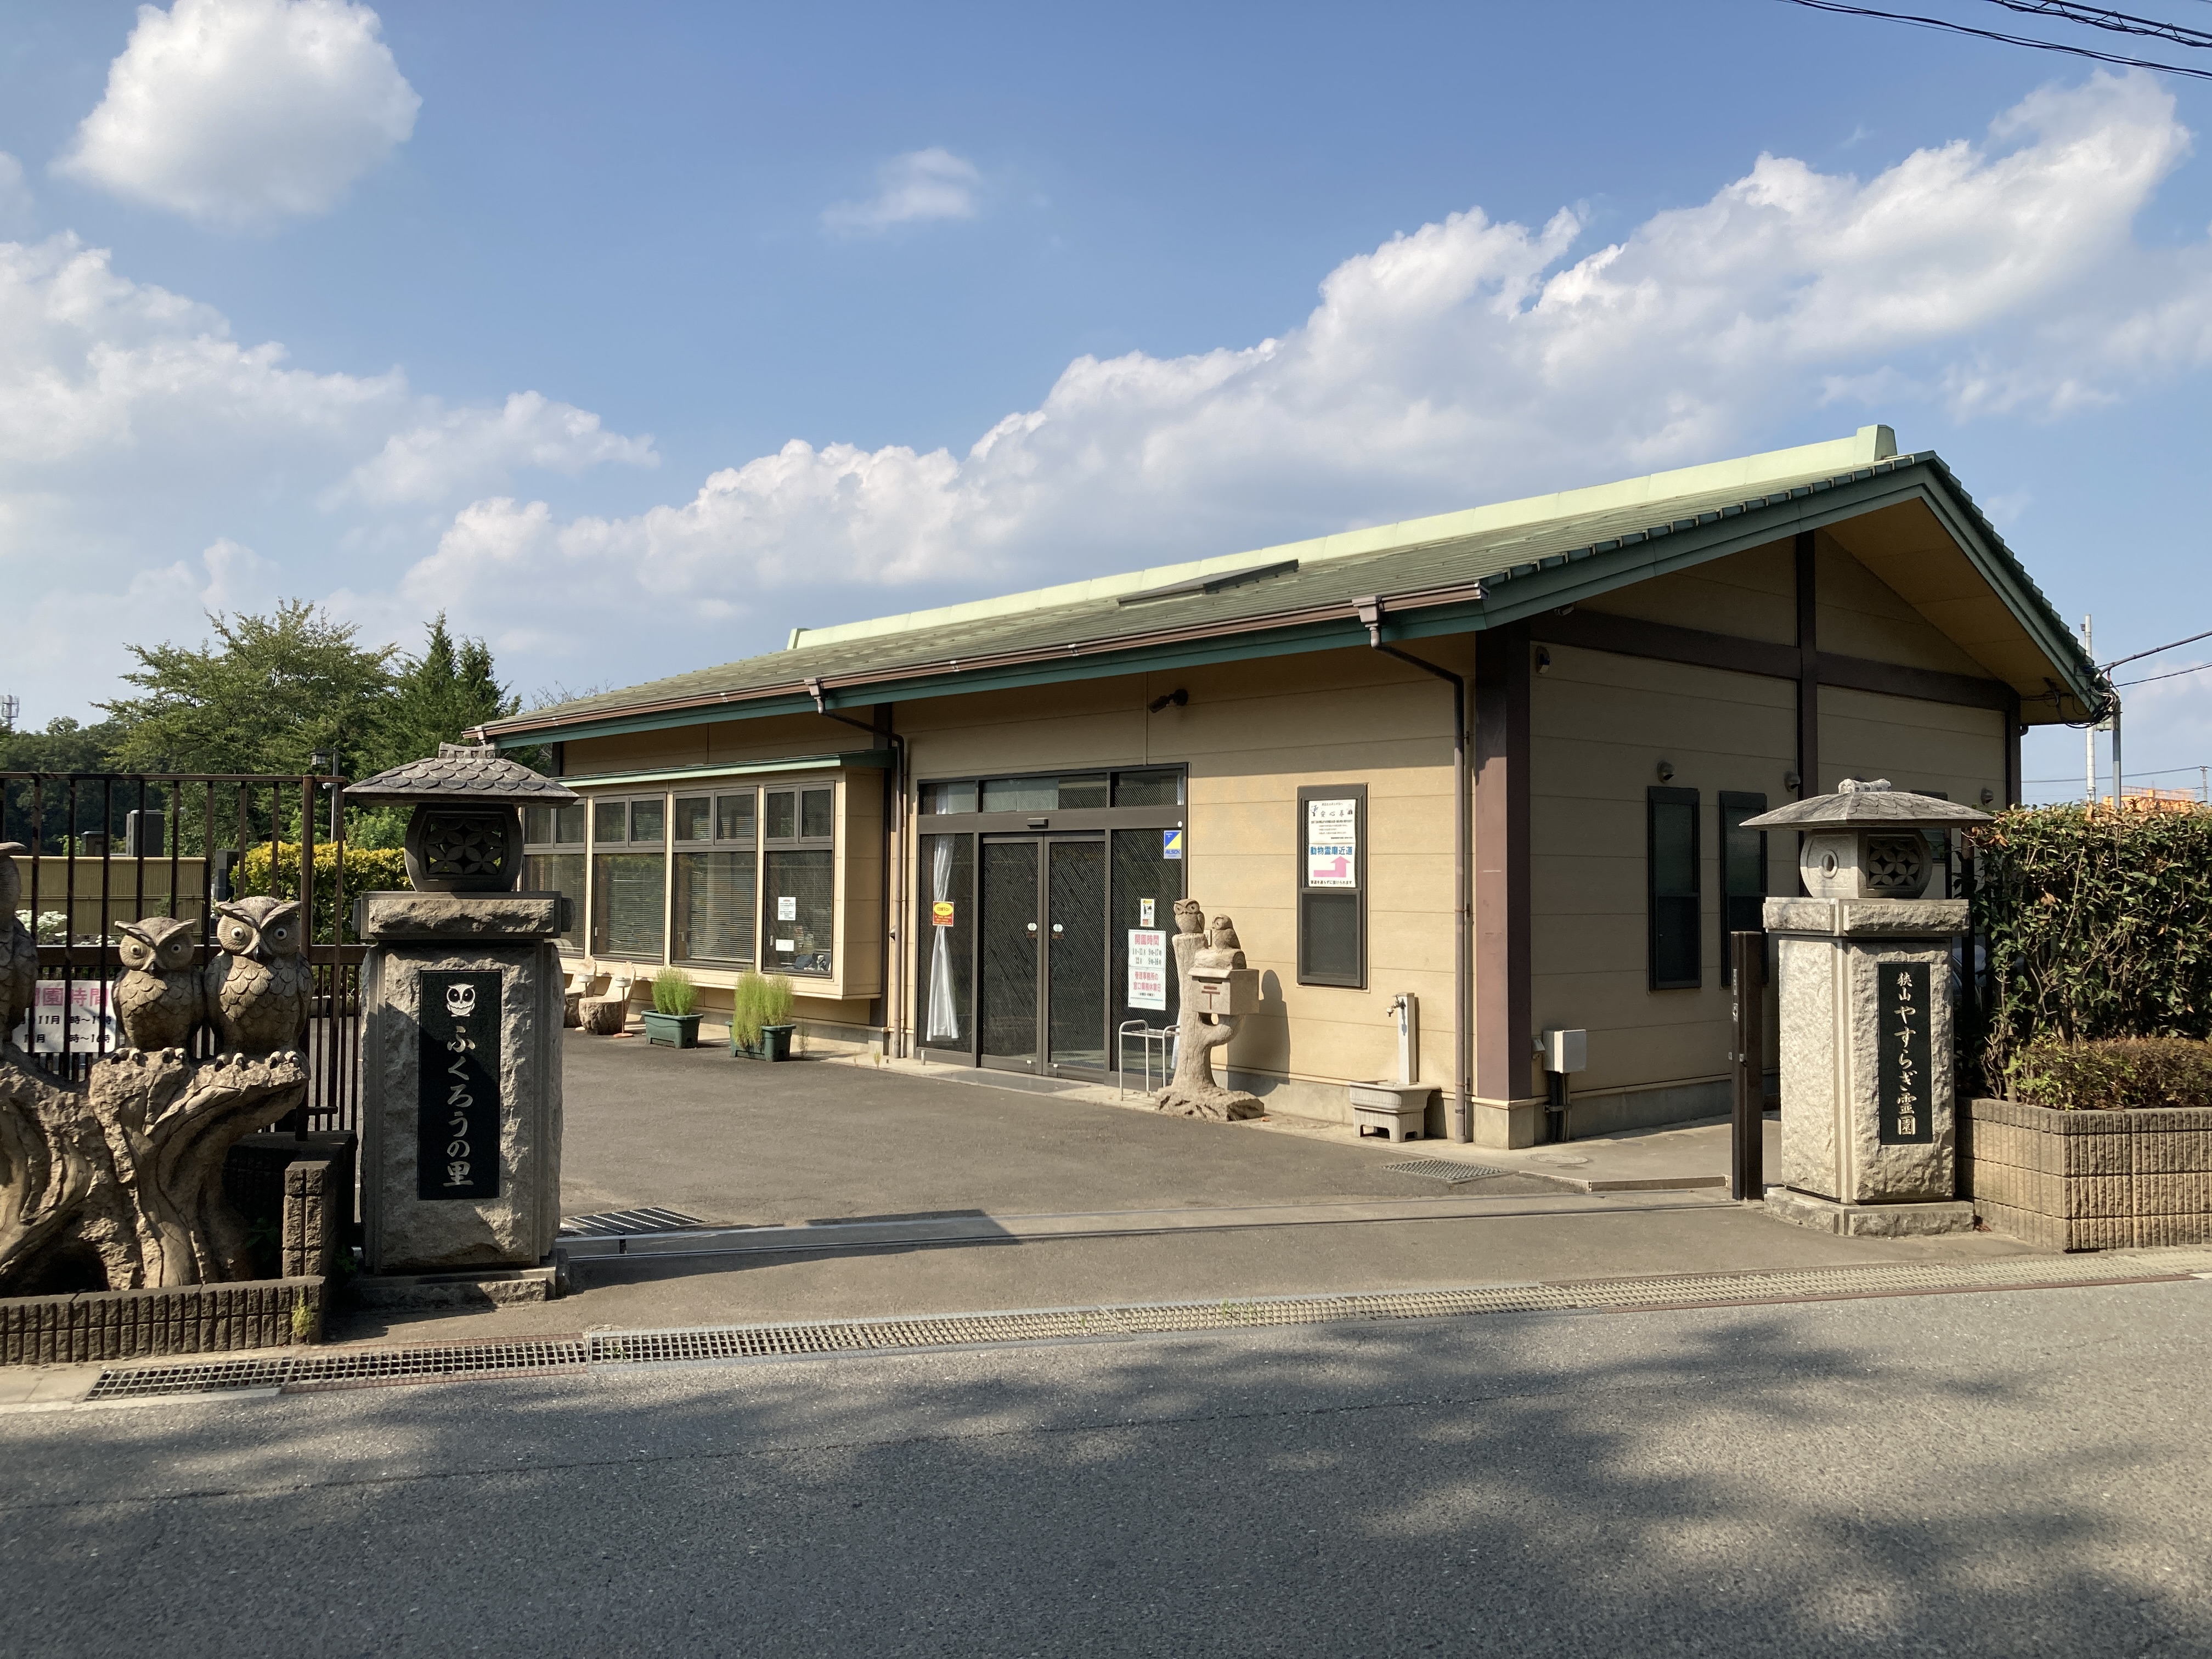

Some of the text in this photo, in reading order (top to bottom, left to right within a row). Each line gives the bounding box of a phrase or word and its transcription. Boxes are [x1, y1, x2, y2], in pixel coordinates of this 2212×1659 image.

[1135, 934, 1159, 946] 開園時間
[443, 1025, 476, 1187] ふくろうの里
[1894, 972, 1918, 1136] 狭山やすらぎ霊園
